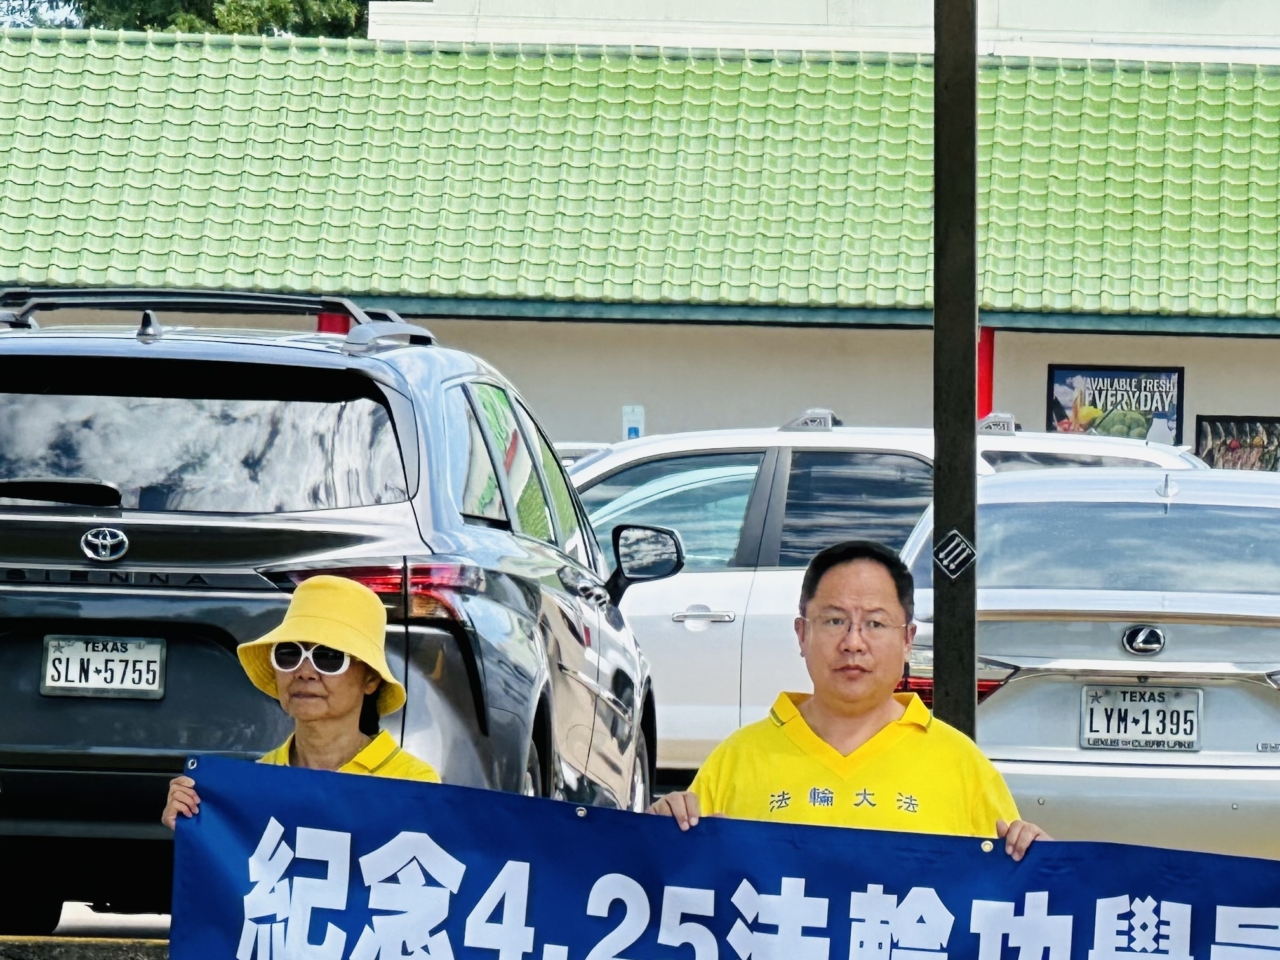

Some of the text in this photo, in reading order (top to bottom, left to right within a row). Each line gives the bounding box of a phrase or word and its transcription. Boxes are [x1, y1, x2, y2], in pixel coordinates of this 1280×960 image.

[1085, 377, 1174, 392] AVAILABLE FRESH
[1085, 390, 1173, 412] EVERYDAY
[5, 568, 209, 586] SIENNA
[83, 640, 128, 653] TEXAS
[1120, 690, 1166, 703] TEXAS
[769, 787, 919, 812] 法輪大法
